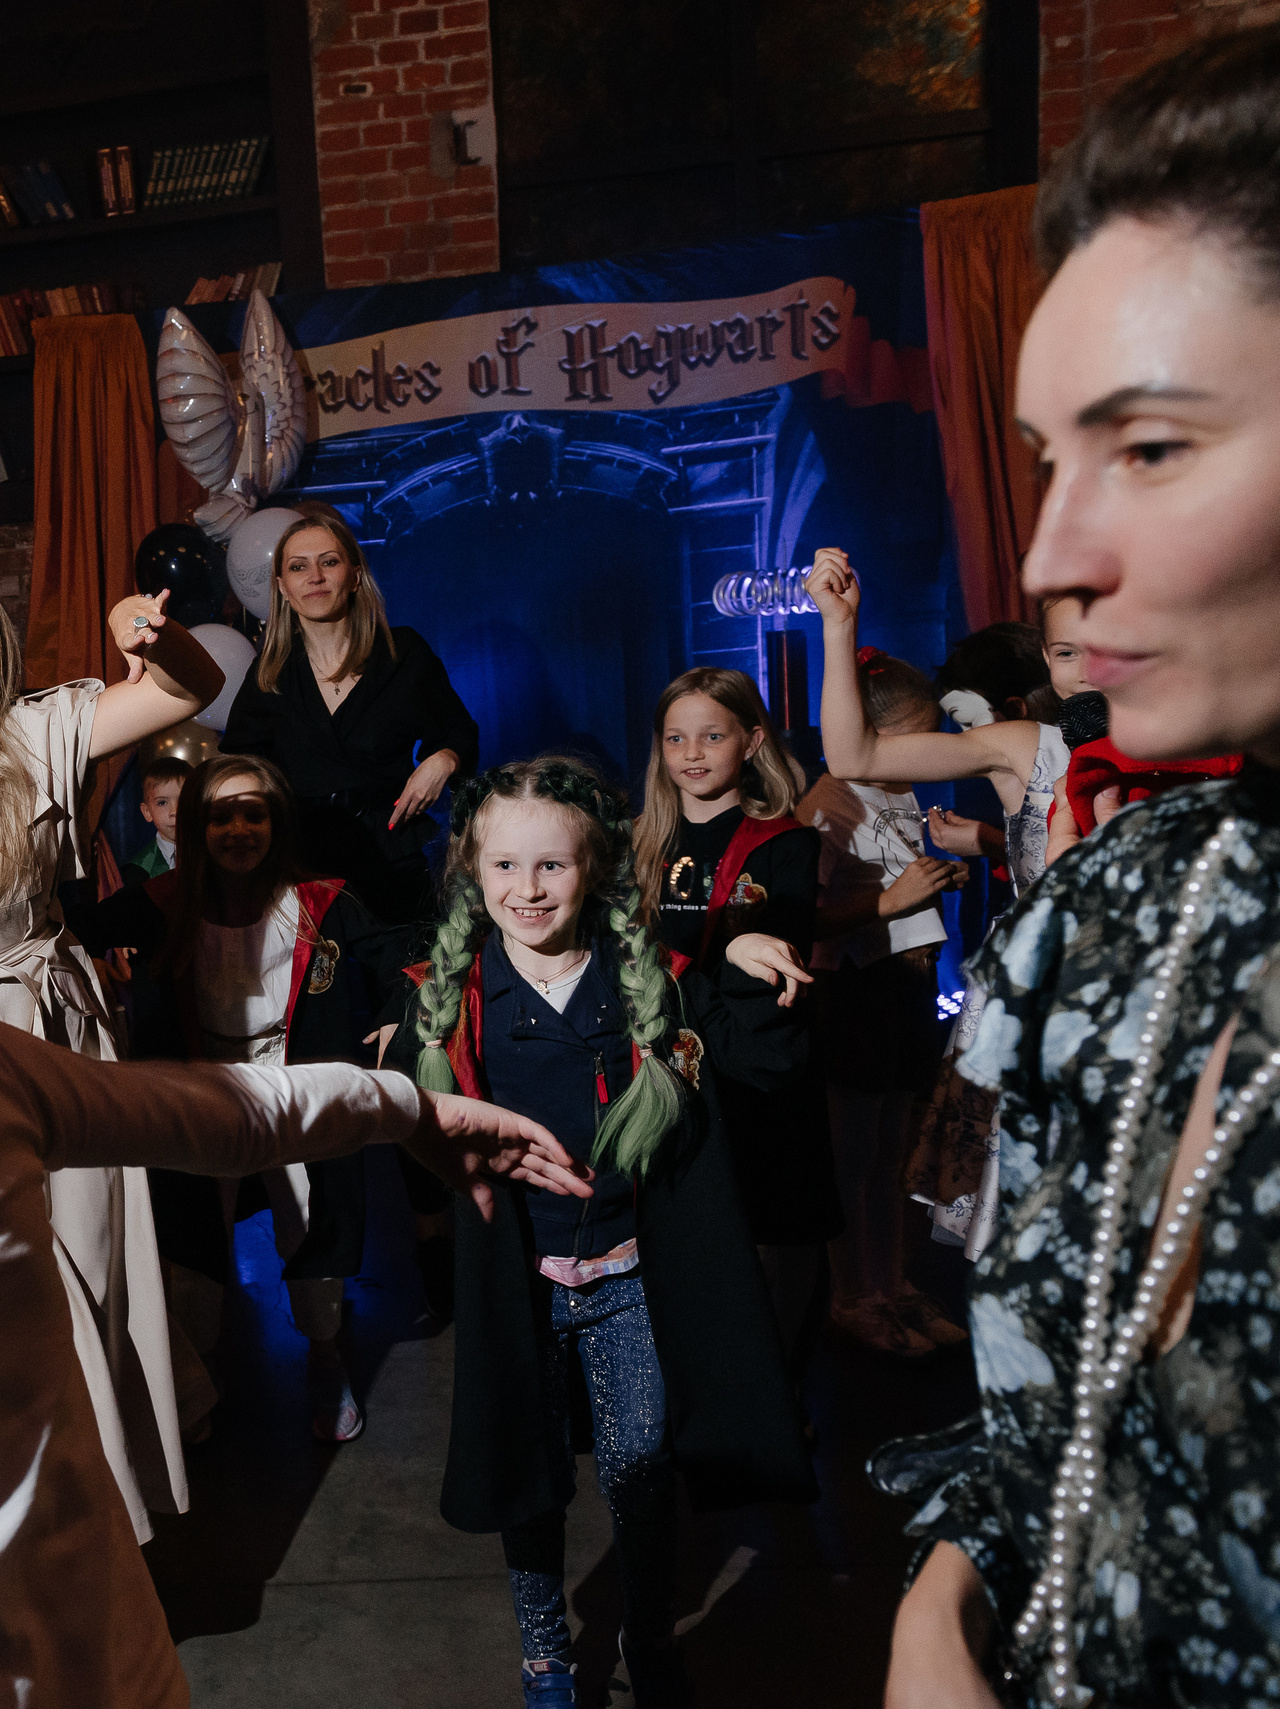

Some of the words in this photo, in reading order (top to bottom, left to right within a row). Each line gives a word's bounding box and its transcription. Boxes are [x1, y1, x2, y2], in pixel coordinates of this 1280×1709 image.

[303, 340, 441, 414] acles
[468, 308, 538, 397] of
[558, 288, 842, 402] Hogwarts
